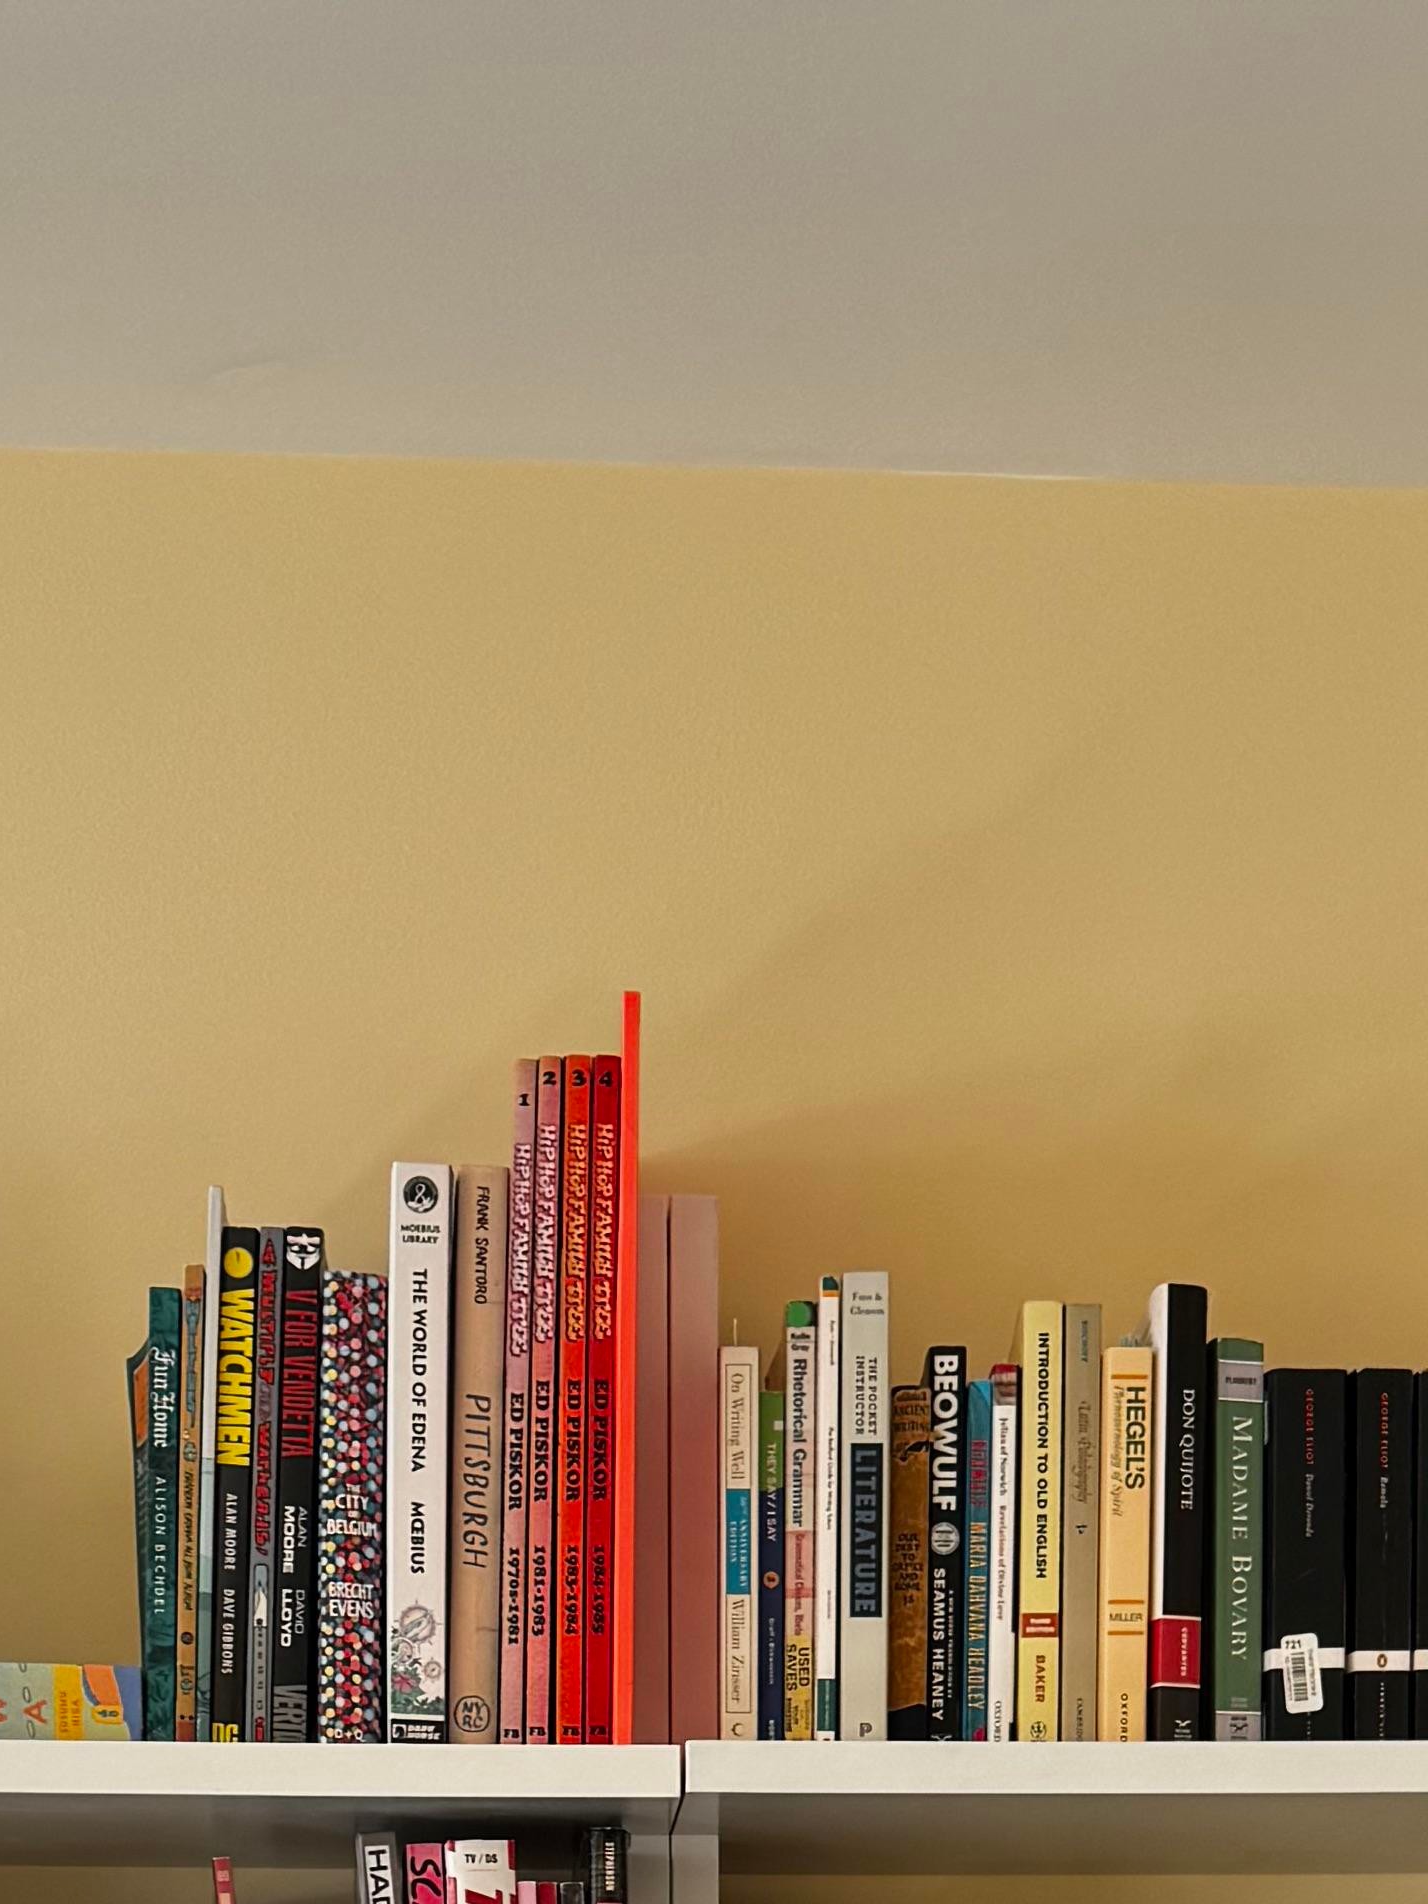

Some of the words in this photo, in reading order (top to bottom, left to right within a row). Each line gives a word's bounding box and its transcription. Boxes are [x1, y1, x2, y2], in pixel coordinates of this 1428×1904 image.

[412, 1268, 428, 1306] THE
[217, 1288, 255, 1468] WATCHMEN
[411, 1309, 430, 1377] WORLD
[411, 1380, 429, 1406] OF
[1037, 1332, 1050, 1450] INTRODUCTION
[1180, 1388, 1196, 1431] DON
[411, 1405, 427, 1472] EDENA
[930, 1354, 959, 1512] BEOWULF
[1037, 1453, 1048, 1473] TO
[1124, 1386, 1146, 1490] HEGEL'S
[462, 1394, 492, 1568] PITTSBURGH
[1036, 1476, 1047, 1509] OLD
[1179, 1434, 1197, 1511] QUIJOTE
[1231, 1415, 1253, 1540] MADAME
[854, 1448, 877, 1614] LITERATURE
[1035, 1512, 1047, 1579] ENGLISH
[931, 1568, 946, 1641] SEAMUS
[1109, 1611, 1143, 1623] MILLER
[1230, 1554, 1253, 1661] BOVARY
[930, 1646, 945, 1721] HEANEY
